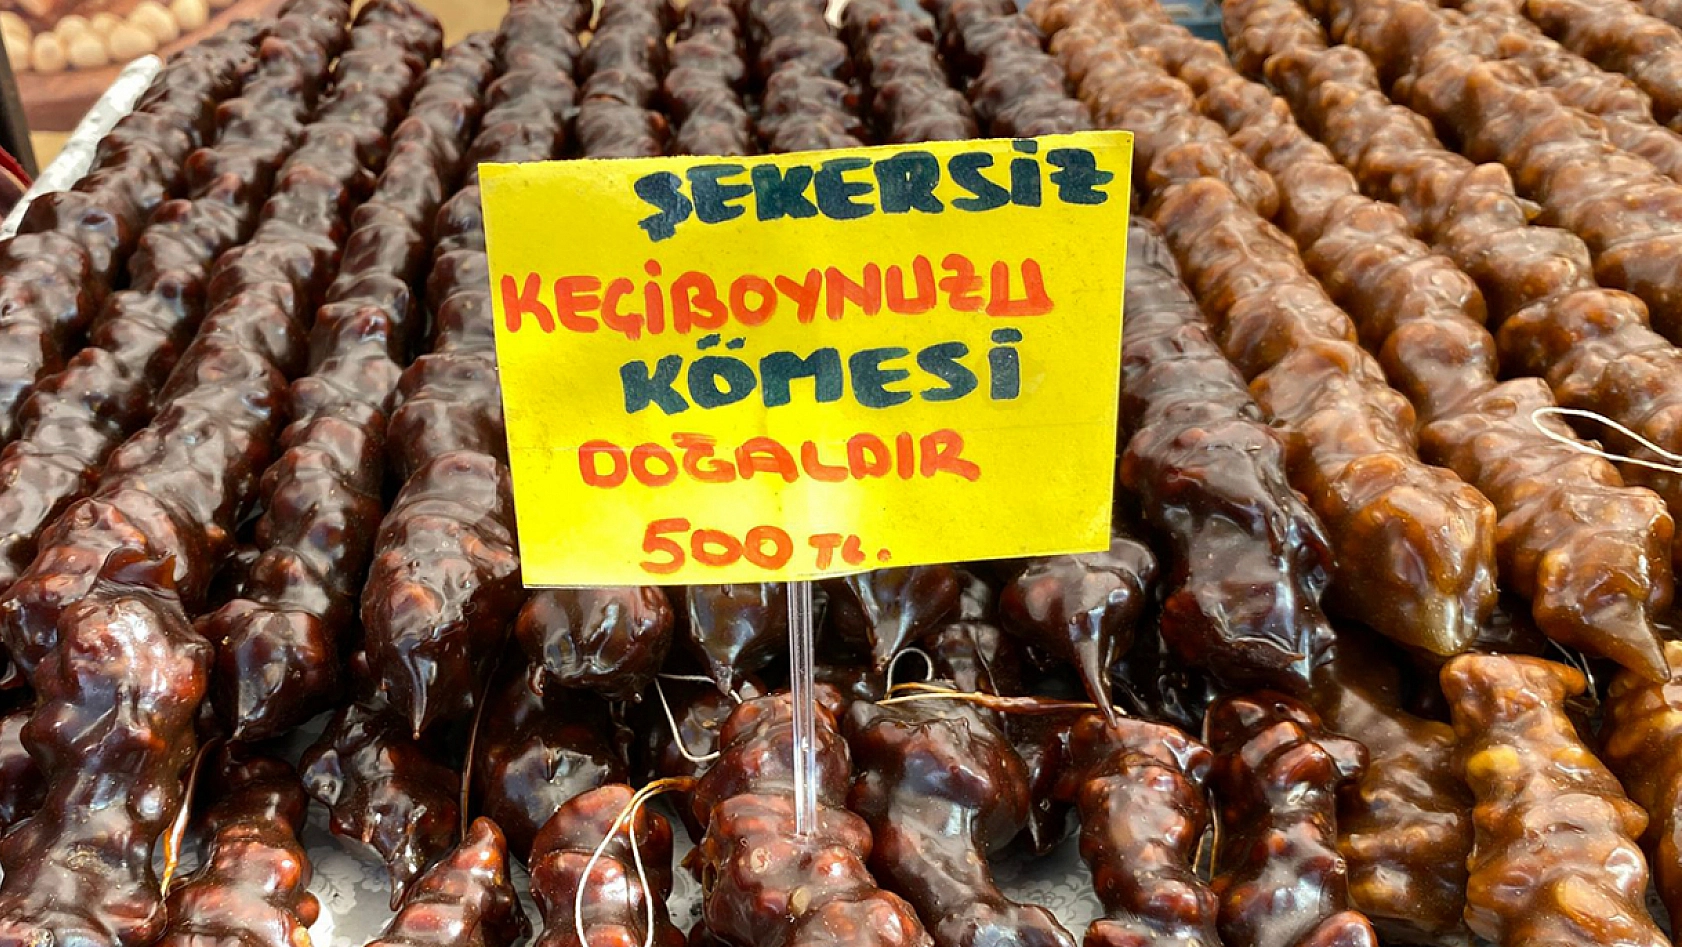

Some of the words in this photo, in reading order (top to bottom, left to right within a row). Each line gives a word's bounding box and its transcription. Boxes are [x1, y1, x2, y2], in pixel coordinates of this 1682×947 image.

[633, 140, 1114, 242] ŞEKERSİZ
[502, 253, 1055, 340] KEÇİBOYNUZU
[621, 329, 1023, 415] KÖMESİ
[578, 428, 981, 490] DOĞALDIR
[641, 518, 794, 574] 500
